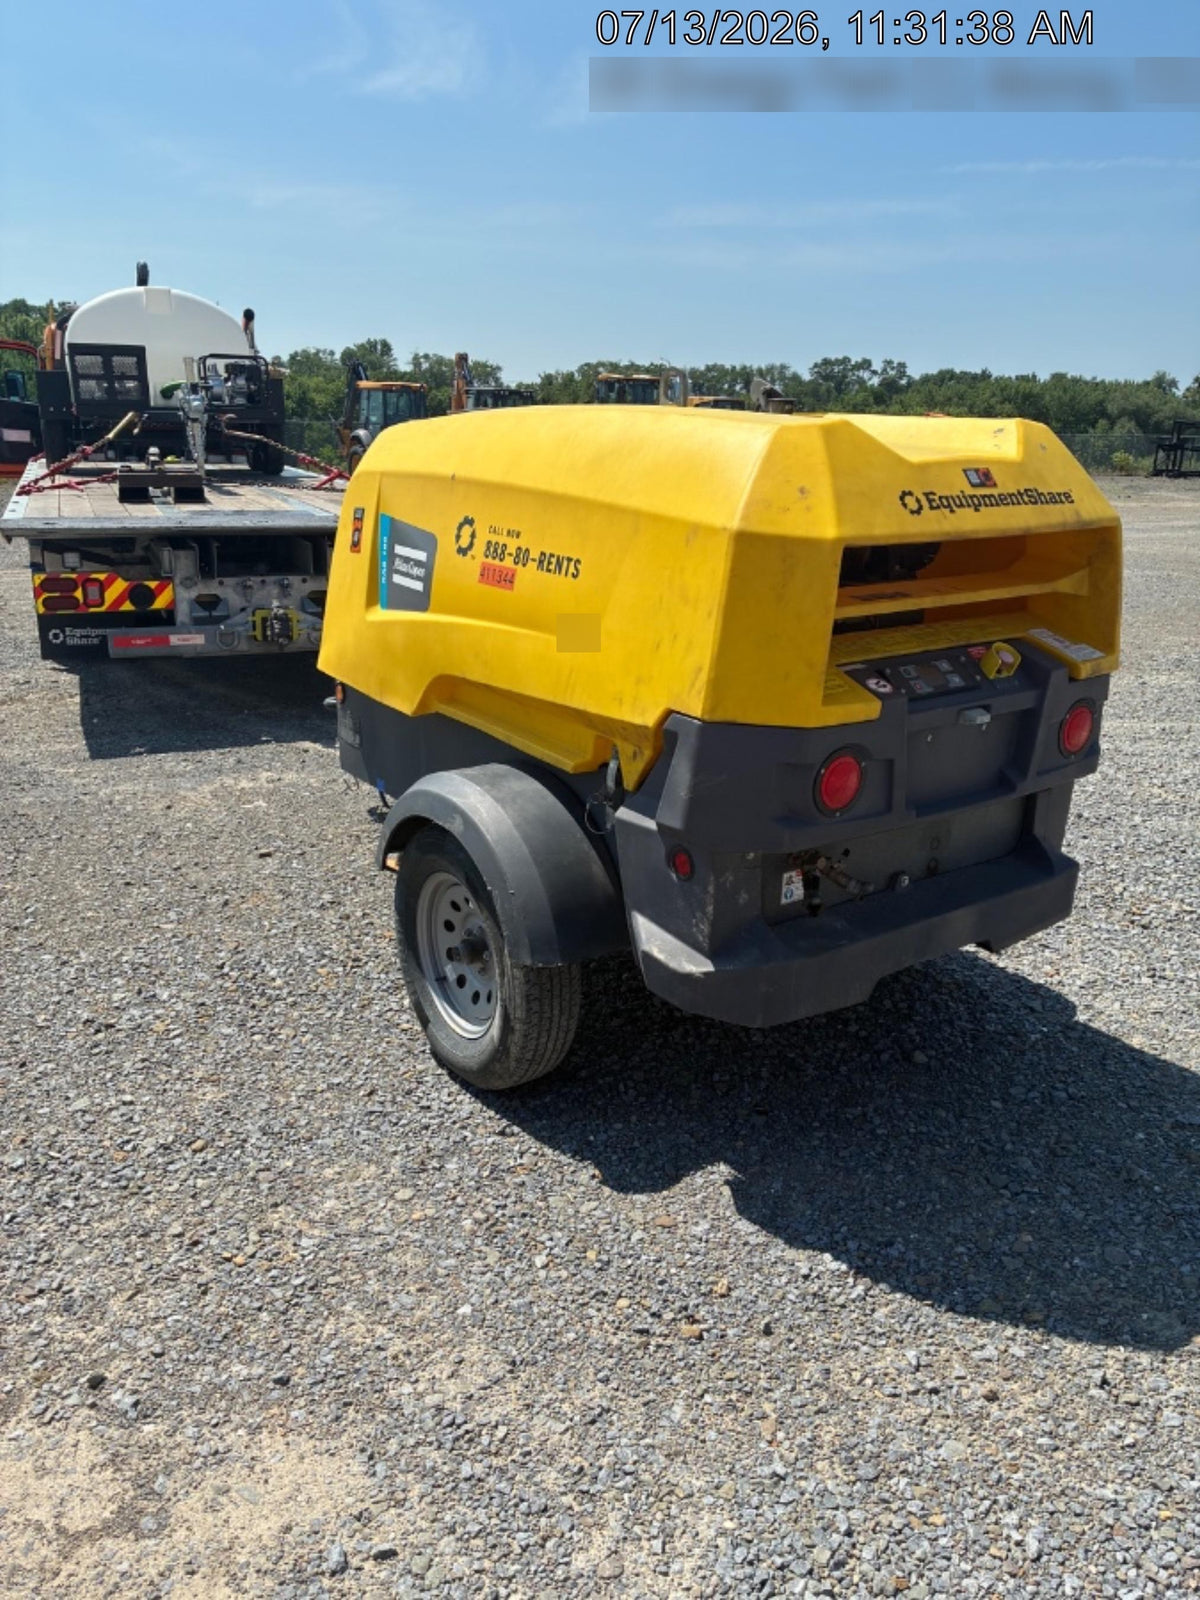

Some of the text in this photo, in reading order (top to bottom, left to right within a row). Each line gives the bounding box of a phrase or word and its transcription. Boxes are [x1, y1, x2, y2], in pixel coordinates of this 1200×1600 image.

[923, 488, 1075, 513] EquipmentShare
[488, 524, 521, 539] CALL NOW
[484, 540, 582, 580] 888-80-RENTS
[65, 636, 100, 646] Share
